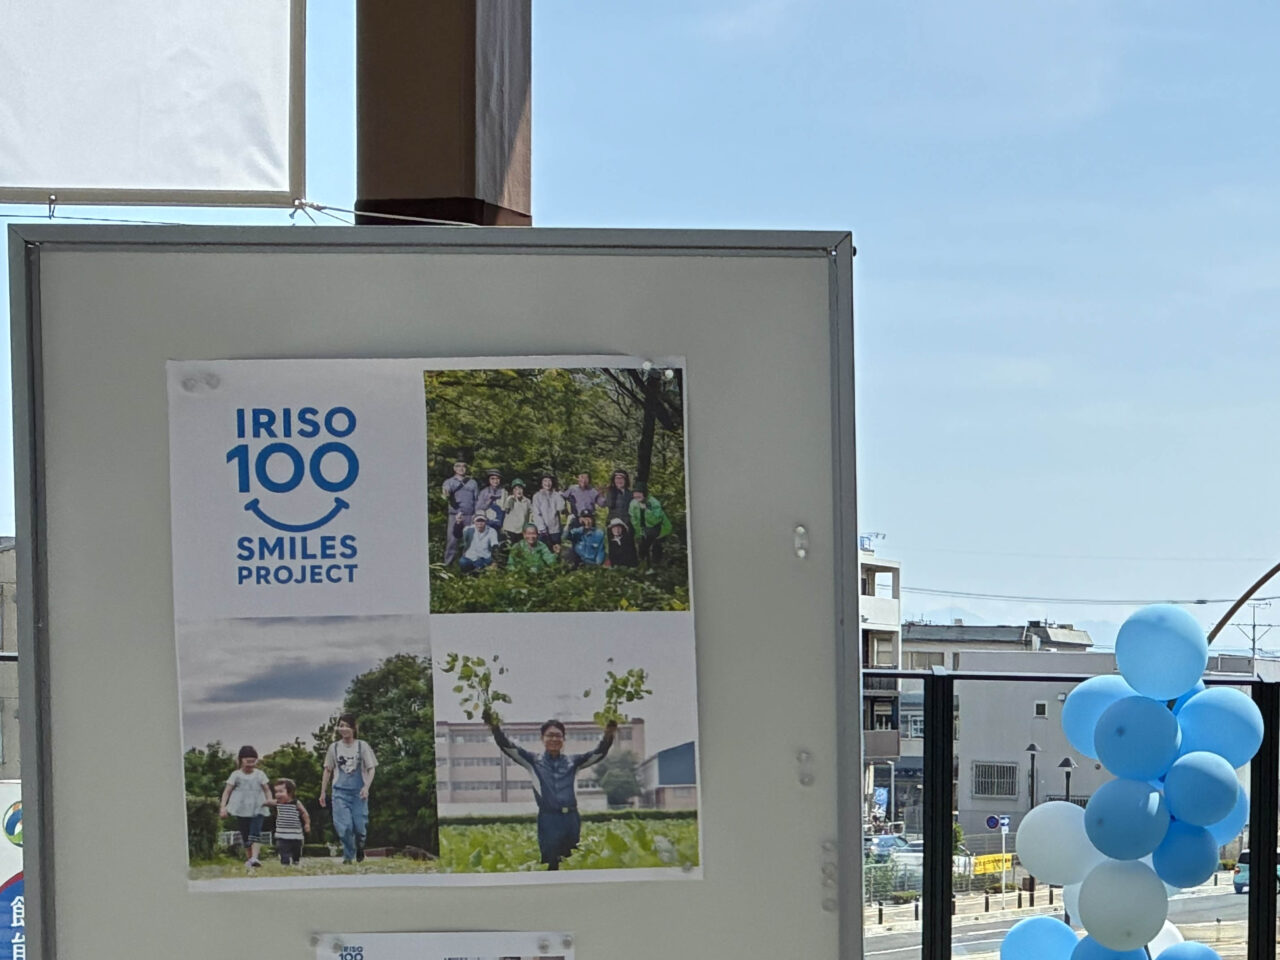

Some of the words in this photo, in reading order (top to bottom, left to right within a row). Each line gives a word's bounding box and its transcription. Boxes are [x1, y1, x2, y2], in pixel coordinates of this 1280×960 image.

[236, 406, 357, 438] IRISO
[226, 441, 360, 493] 100
[236, 534, 358, 561] SMILES
[237, 564, 358, 585] PROJECT
